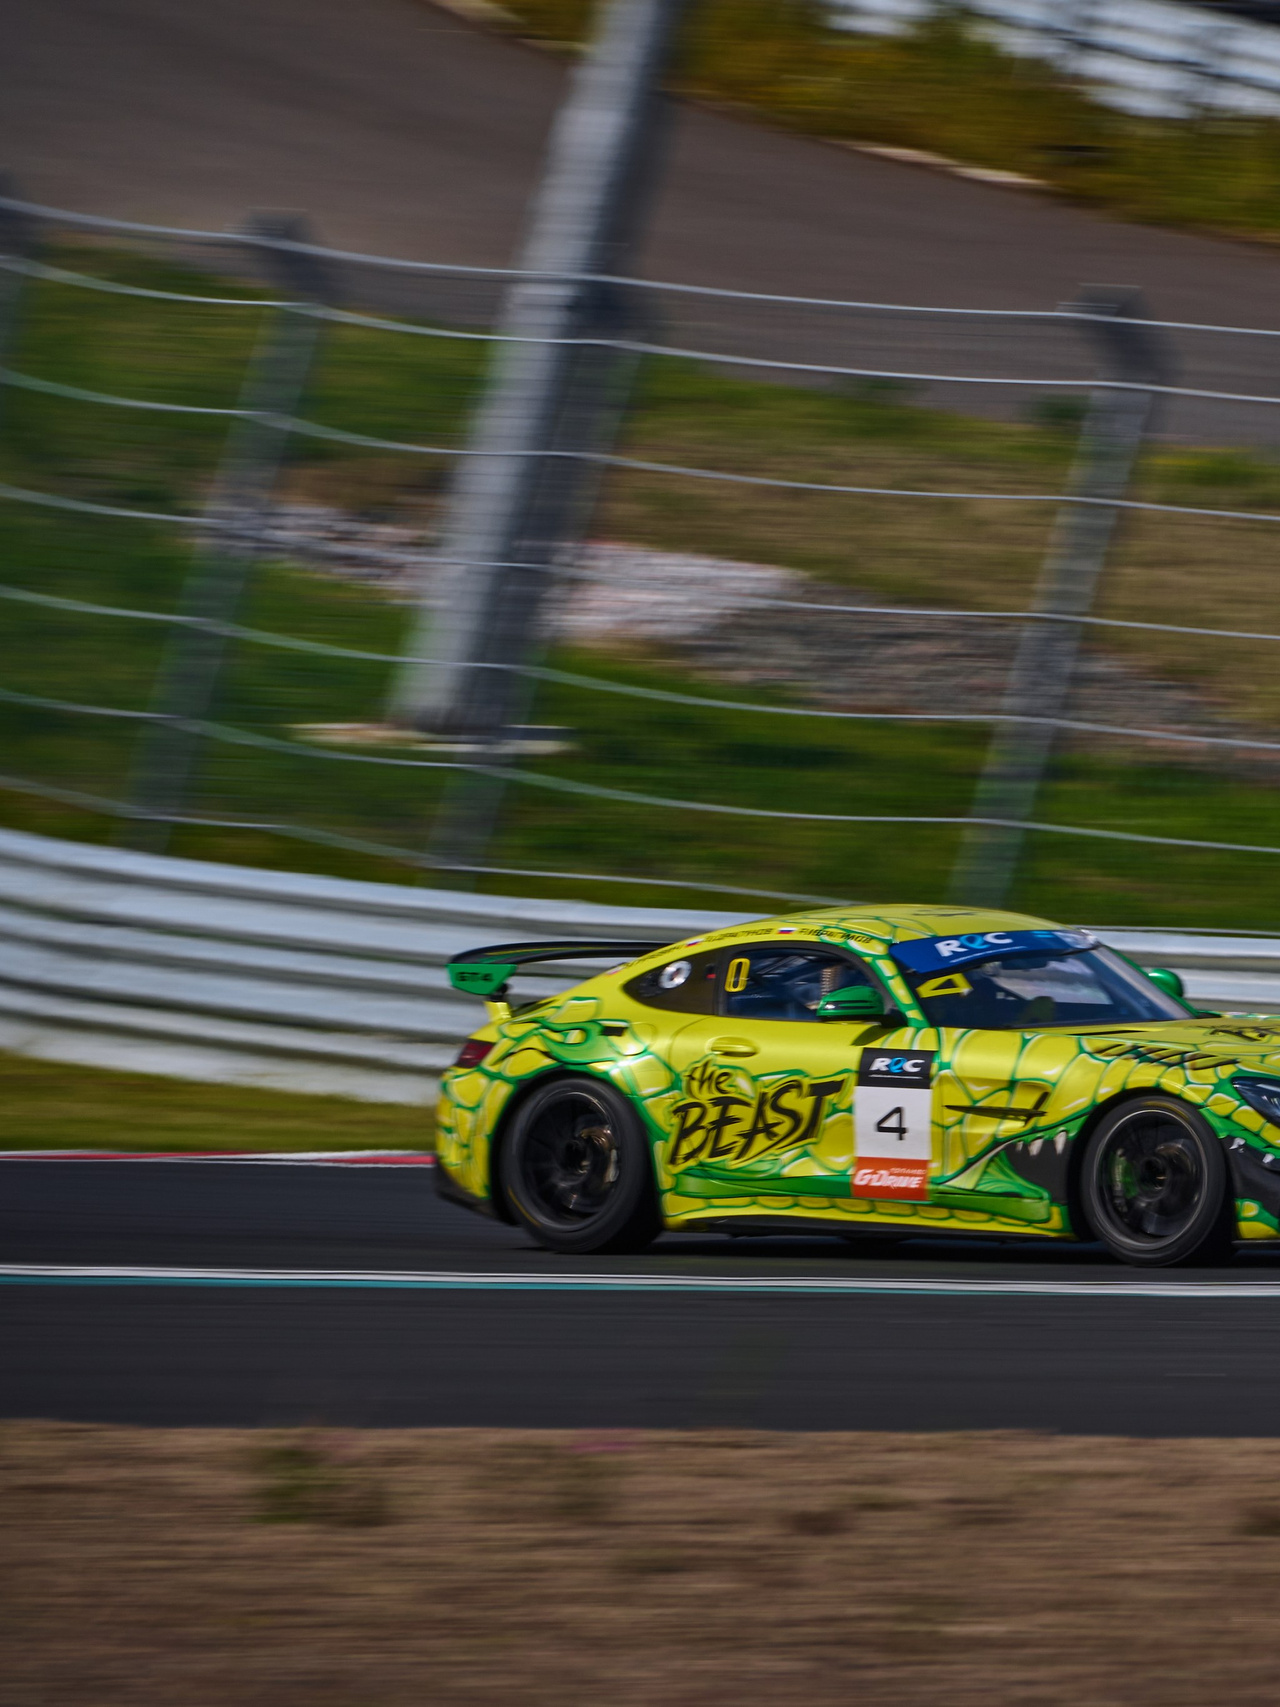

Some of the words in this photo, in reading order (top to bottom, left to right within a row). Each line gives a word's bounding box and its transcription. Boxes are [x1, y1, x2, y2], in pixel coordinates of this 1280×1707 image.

[915, 973, 974, 998] 4
[683, 1060, 733, 1099] the
[668, 1078, 846, 1166] BEAST
[876, 1106, 909, 1141] 4
